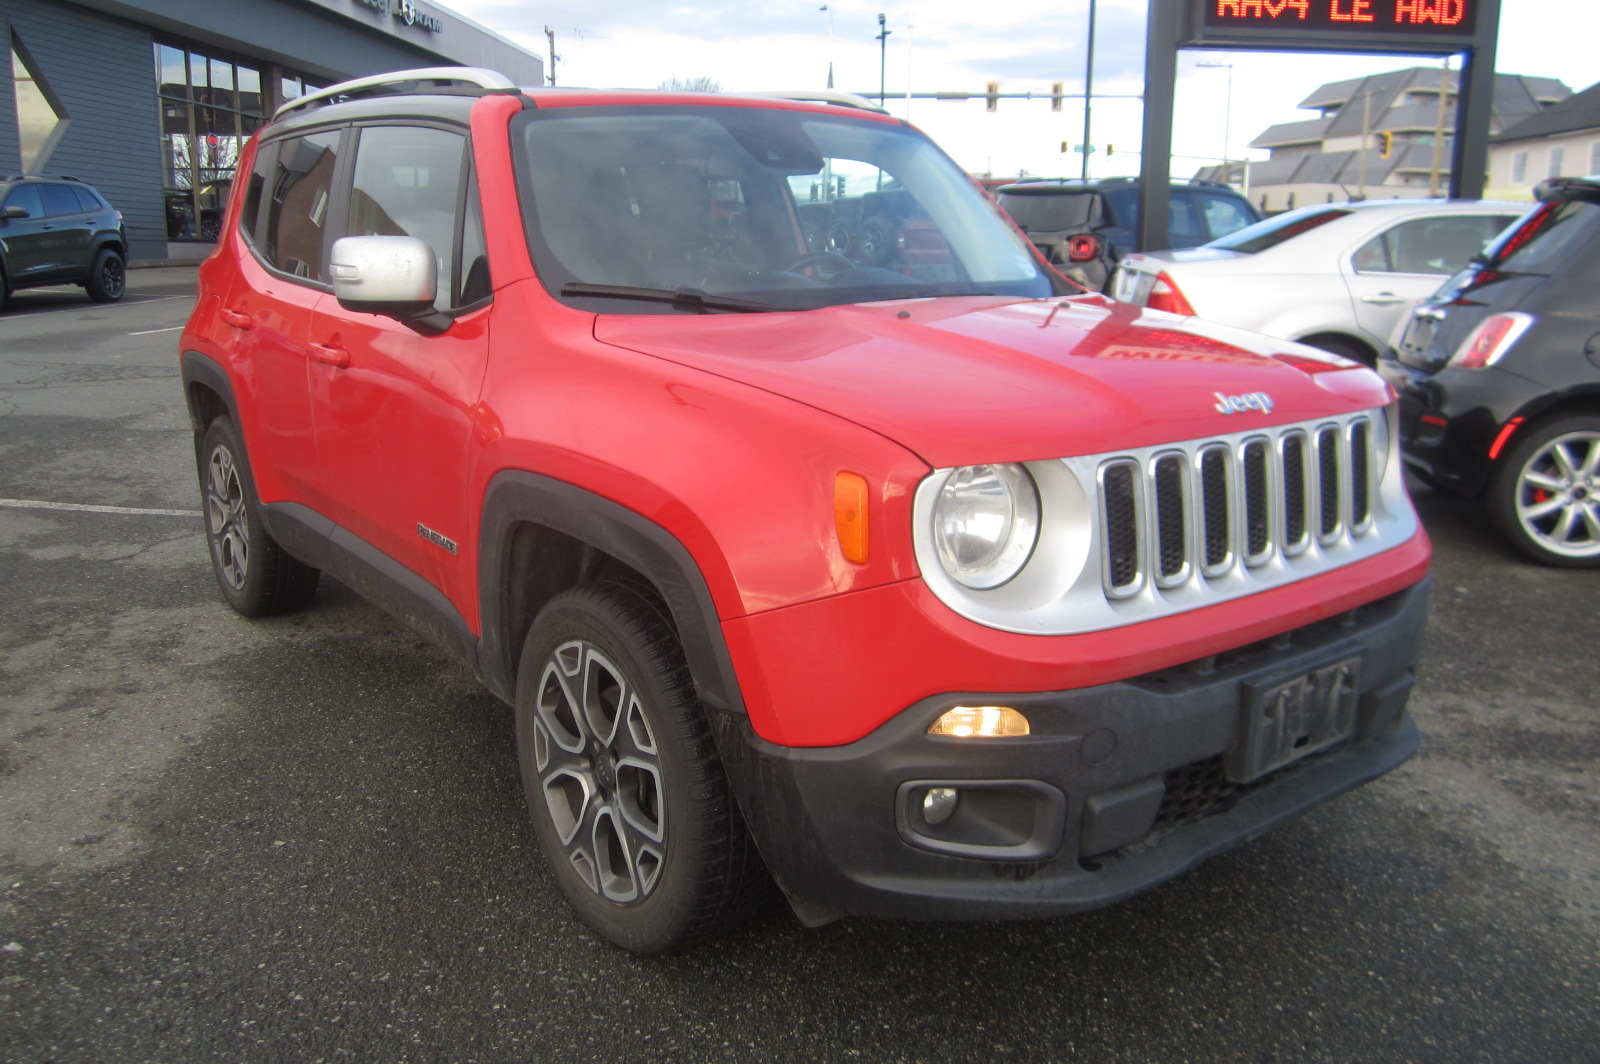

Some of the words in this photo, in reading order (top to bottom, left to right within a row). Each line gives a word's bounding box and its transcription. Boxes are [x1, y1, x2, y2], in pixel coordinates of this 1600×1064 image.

[415, 10, 442, 33] RAM
[1330, 0, 1374, 22] LE
[1394, 0, 1464, 25] AWD
[1213, 391, 1274, 415] Jeep
